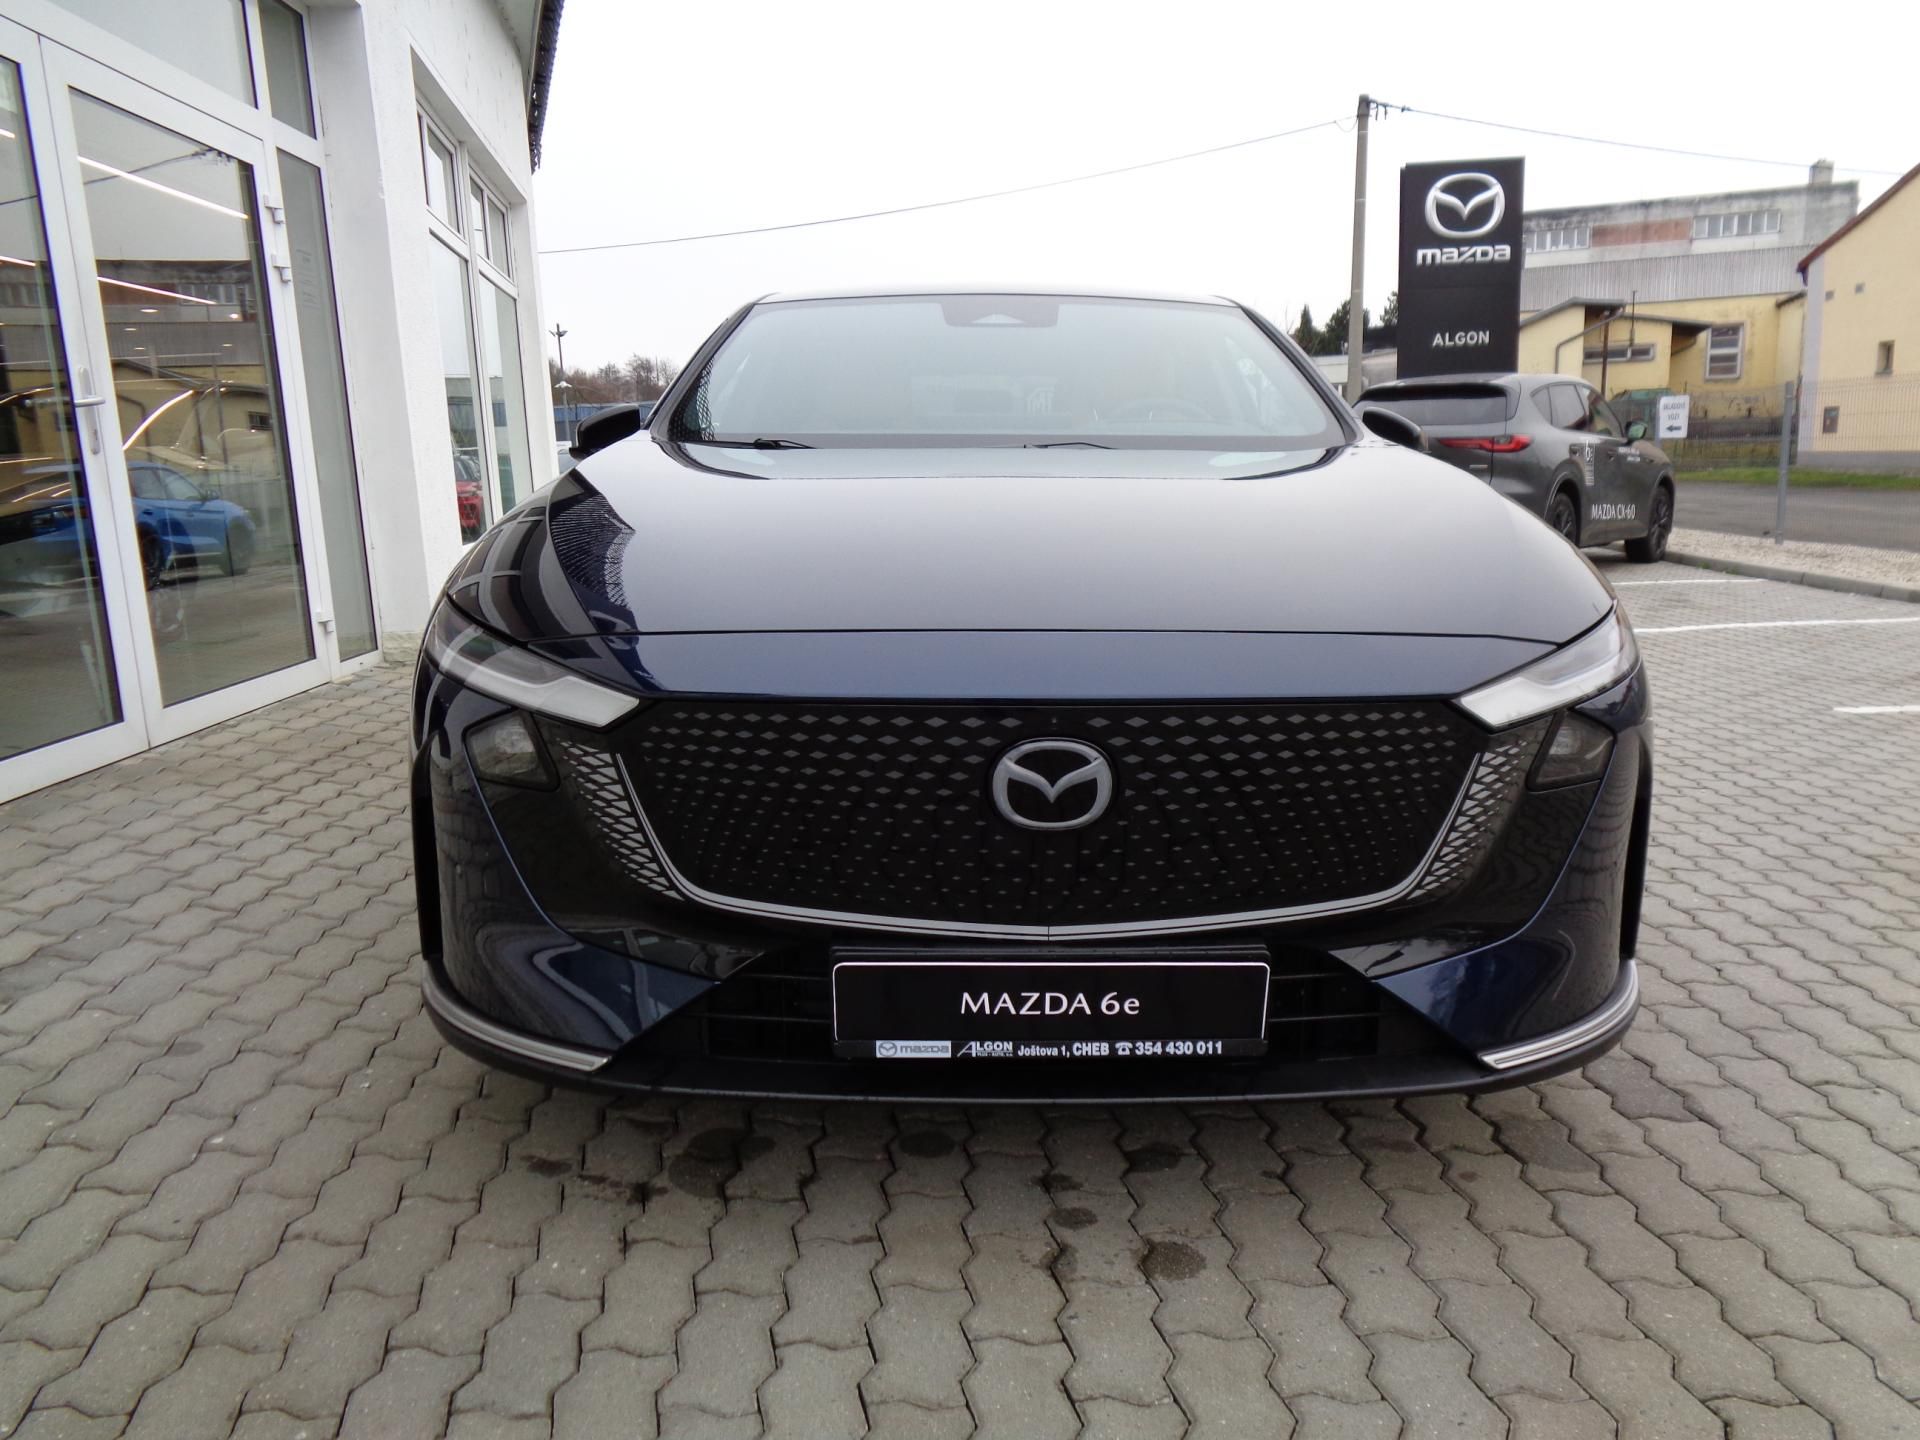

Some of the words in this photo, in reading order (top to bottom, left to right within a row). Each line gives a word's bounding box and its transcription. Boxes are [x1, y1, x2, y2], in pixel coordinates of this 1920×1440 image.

[1416, 244, 1511, 266] mazda
[1432, 330, 1490, 347] ALGON
[1592, 503, 1616, 520] MAZDA
[1617, 503, 1636, 520] CX-60
[961, 992, 1092, 1015] MAZDA
[1100, 991, 1140, 1015] 6e
[957, 1041, 1013, 1058] ALGON
[1018, 1044, 1059, 1057] Joštova
[1072, 1042, 1110, 1056] CHEB
[1135, 1041, 1162, 1055] 354
[1165, 1041, 1193, 1054] 430
[1196, 1041, 1223, 1054] 011
